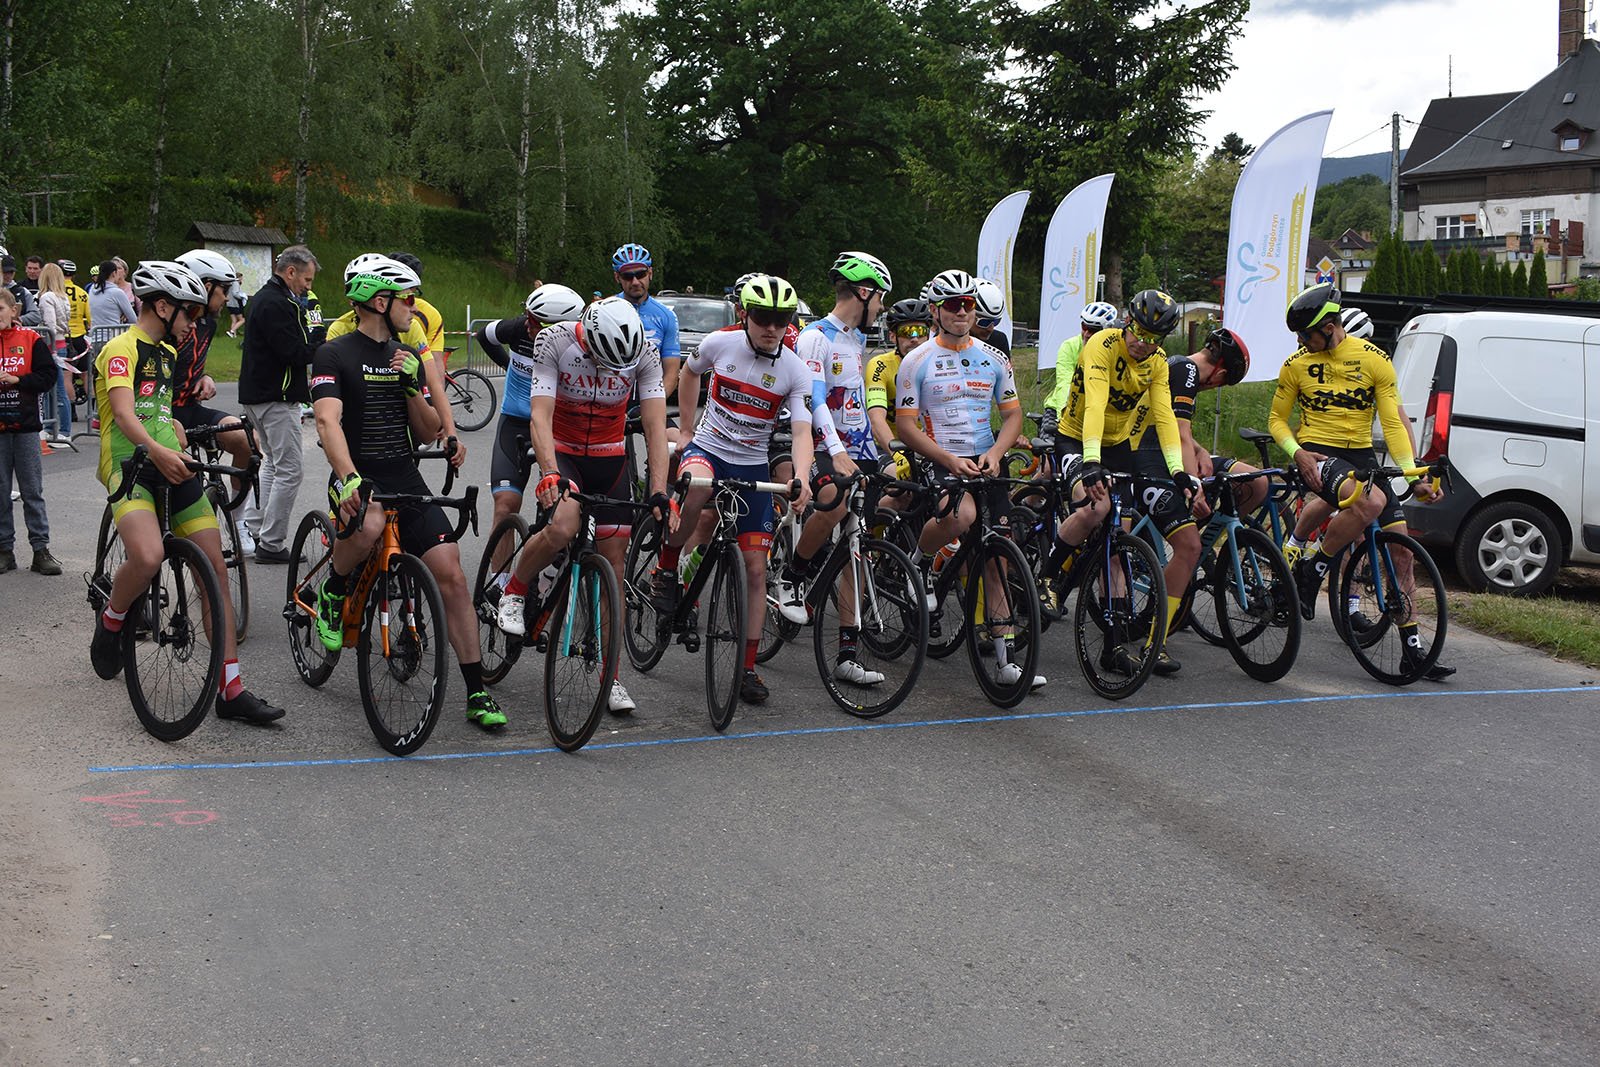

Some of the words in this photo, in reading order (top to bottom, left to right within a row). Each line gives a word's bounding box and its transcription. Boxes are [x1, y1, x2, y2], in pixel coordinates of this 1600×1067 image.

[1266, 214, 1279, 258] Podgórzyn
[592, 309, 600, 332] KASK
[560, 371, 632, 391] RAWEX
[1307, 363, 1325, 384] q
[1130, 405, 1150, 437] quest
